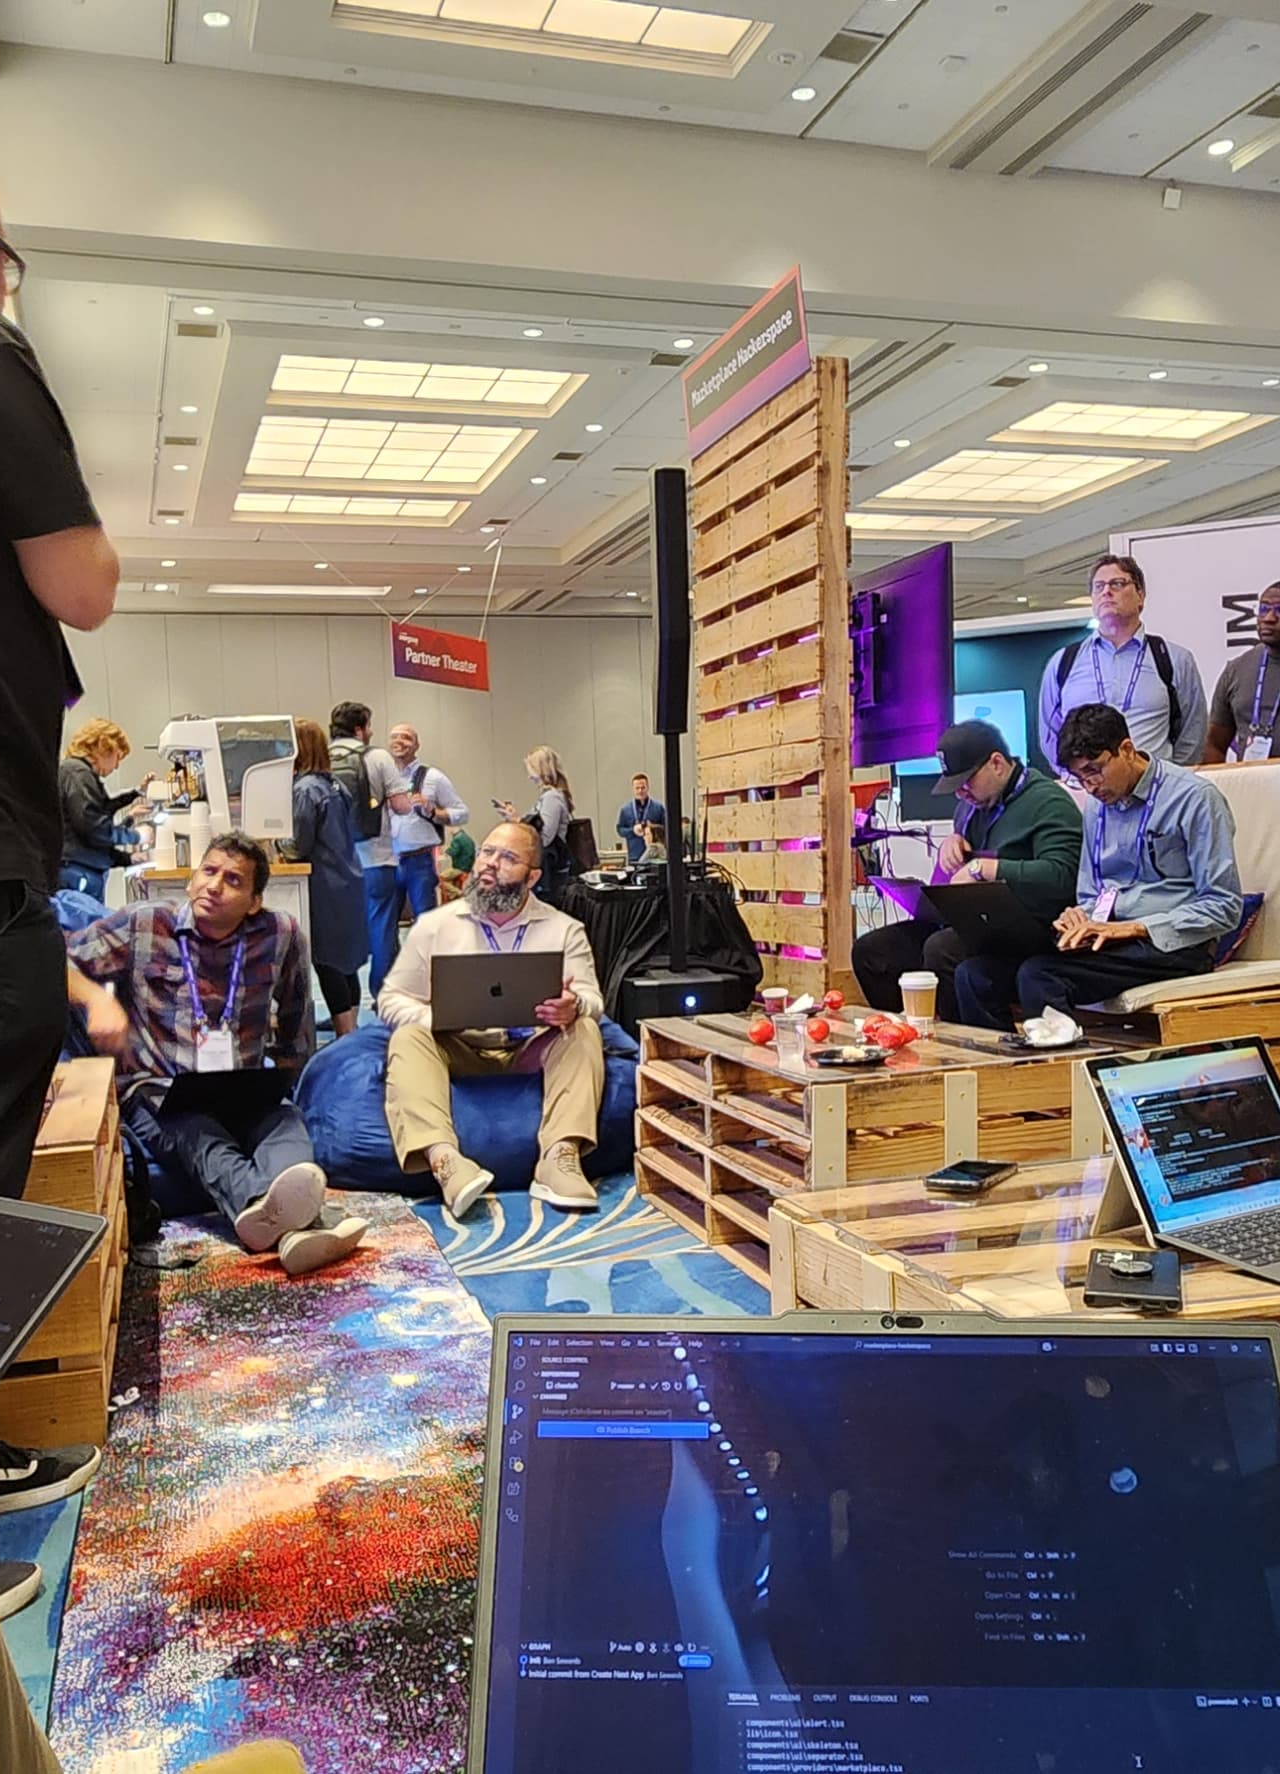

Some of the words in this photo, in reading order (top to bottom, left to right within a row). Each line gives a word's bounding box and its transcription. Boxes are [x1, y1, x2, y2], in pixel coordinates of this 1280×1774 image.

[691, 359, 738, 408] Marketplace
[736, 309, 793, 367] Hackerspace
[405, 647, 441, 667] Partner
[441, 654, 478, 673] Theater
[530, 1339, 541, 1347] File
[547, 1339, 560, 1347] Edit
[566, 1339, 594, 1347] Selection
[600, 1339, 615, 1347] View
[637, 1339, 650, 1347] Run
[688, 1340, 703, 1348] Help
[529, 1670, 546, 1679] Initial
[548, 1671, 572, 1679] commit
[574, 1671, 589, 1679] from
[591, 1671, 612, 1679] Create
[614, 1671, 629, 1679] Next
[630, 1671, 644, 1680] App
[770, 1694, 801, 1702] PROBLEMS
[813, 1694, 837, 1702] OUTPUT
[849, 1694, 870, 1703] DEBUG
[870, 1695, 898, 1703] CONSOLE
[910, 1694, 929, 1703] PORTS
